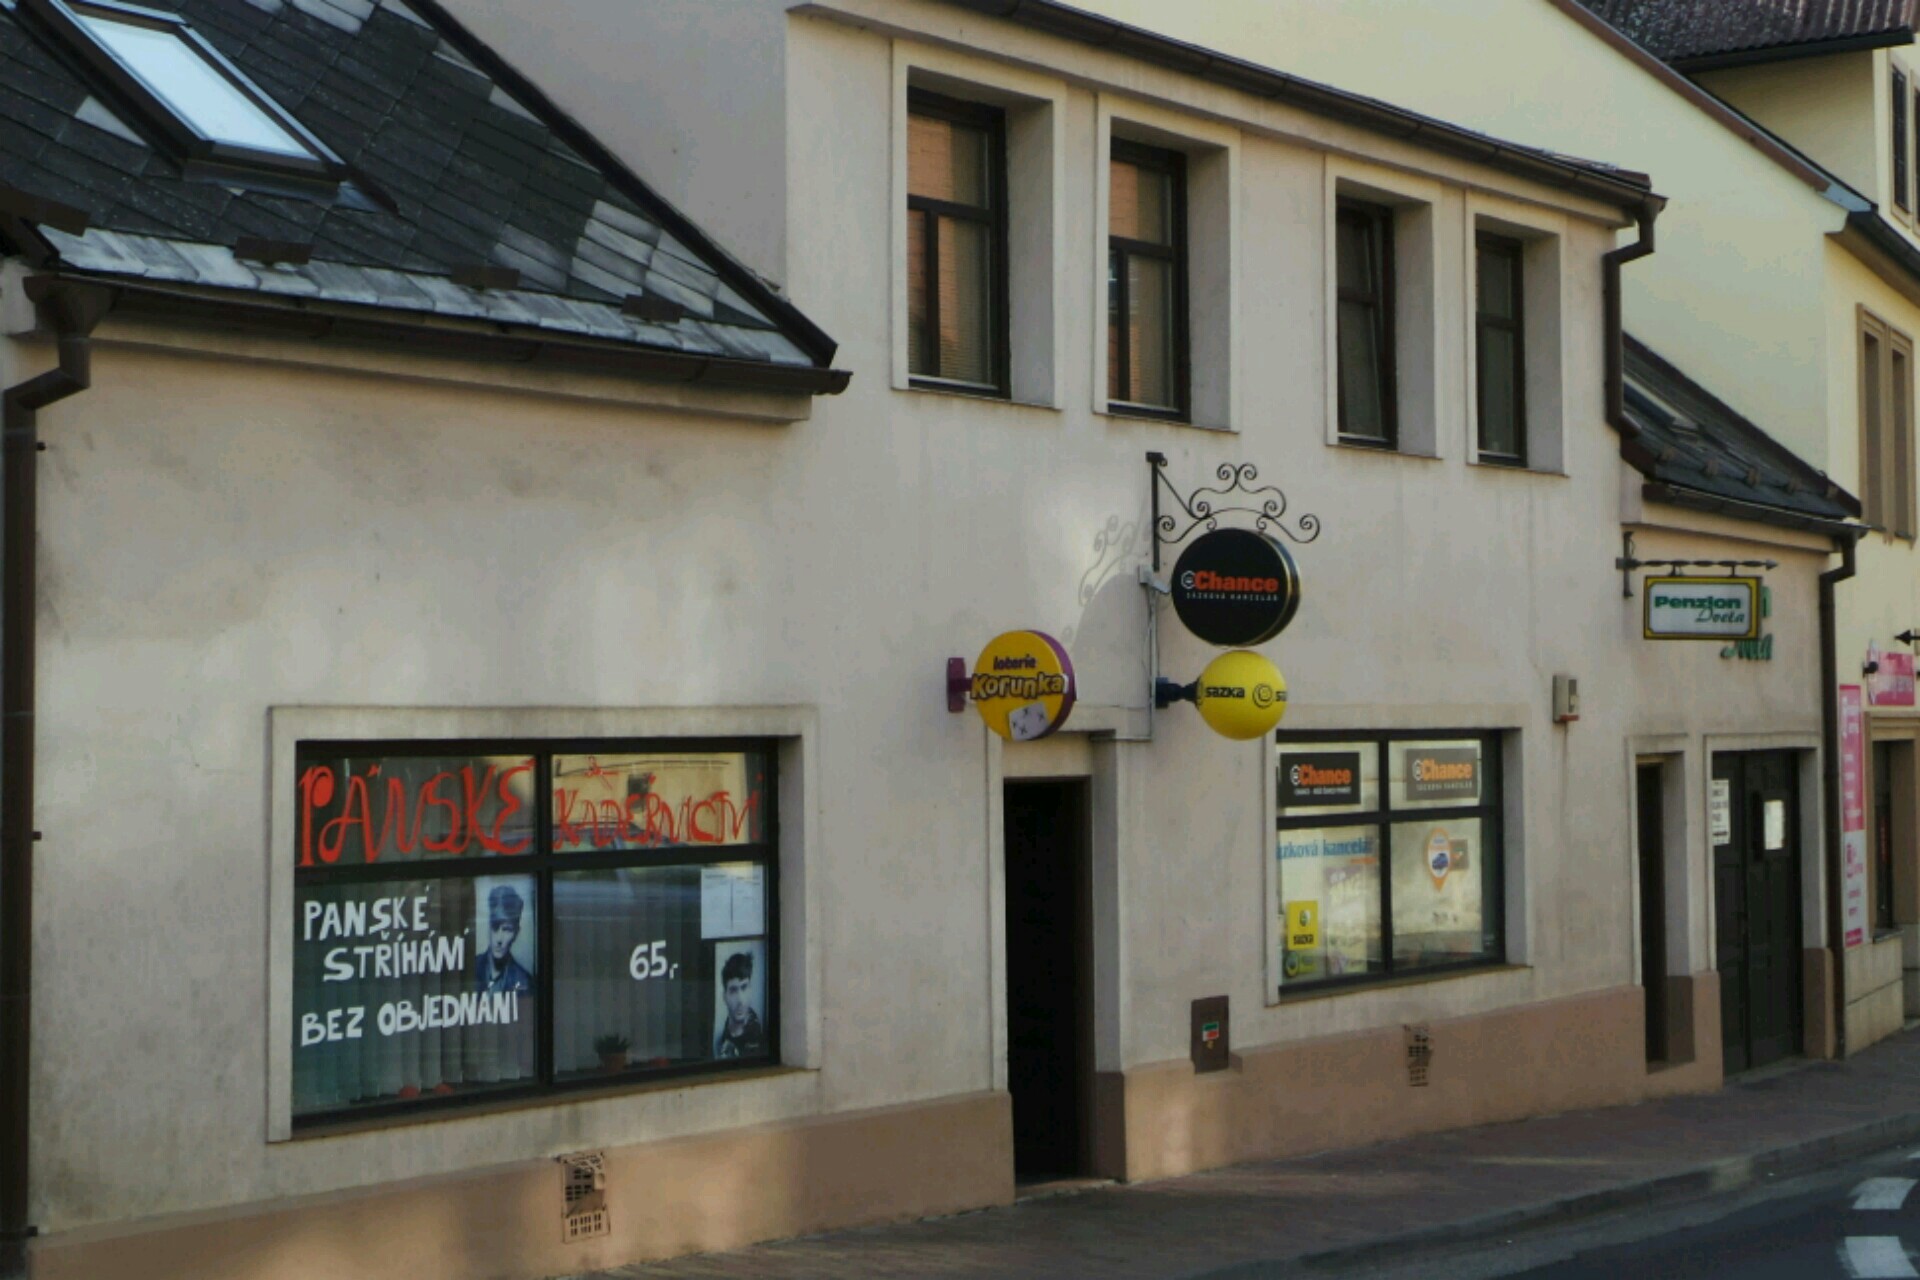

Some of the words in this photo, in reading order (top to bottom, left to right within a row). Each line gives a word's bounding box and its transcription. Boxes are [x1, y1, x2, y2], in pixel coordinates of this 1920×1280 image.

[1194, 570, 1279, 592] Chance
[1654, 595, 1742, 609] Penzion
[993, 653, 1037, 671] loterie
[970, 671, 1068, 700] Korunka
[1299, 763, 1353, 785] Chance
[1422, 758, 1473, 781] Chance
[299, 757, 536, 867] PÁNSKÉ
[300, 1006, 366, 1048] BEZ
